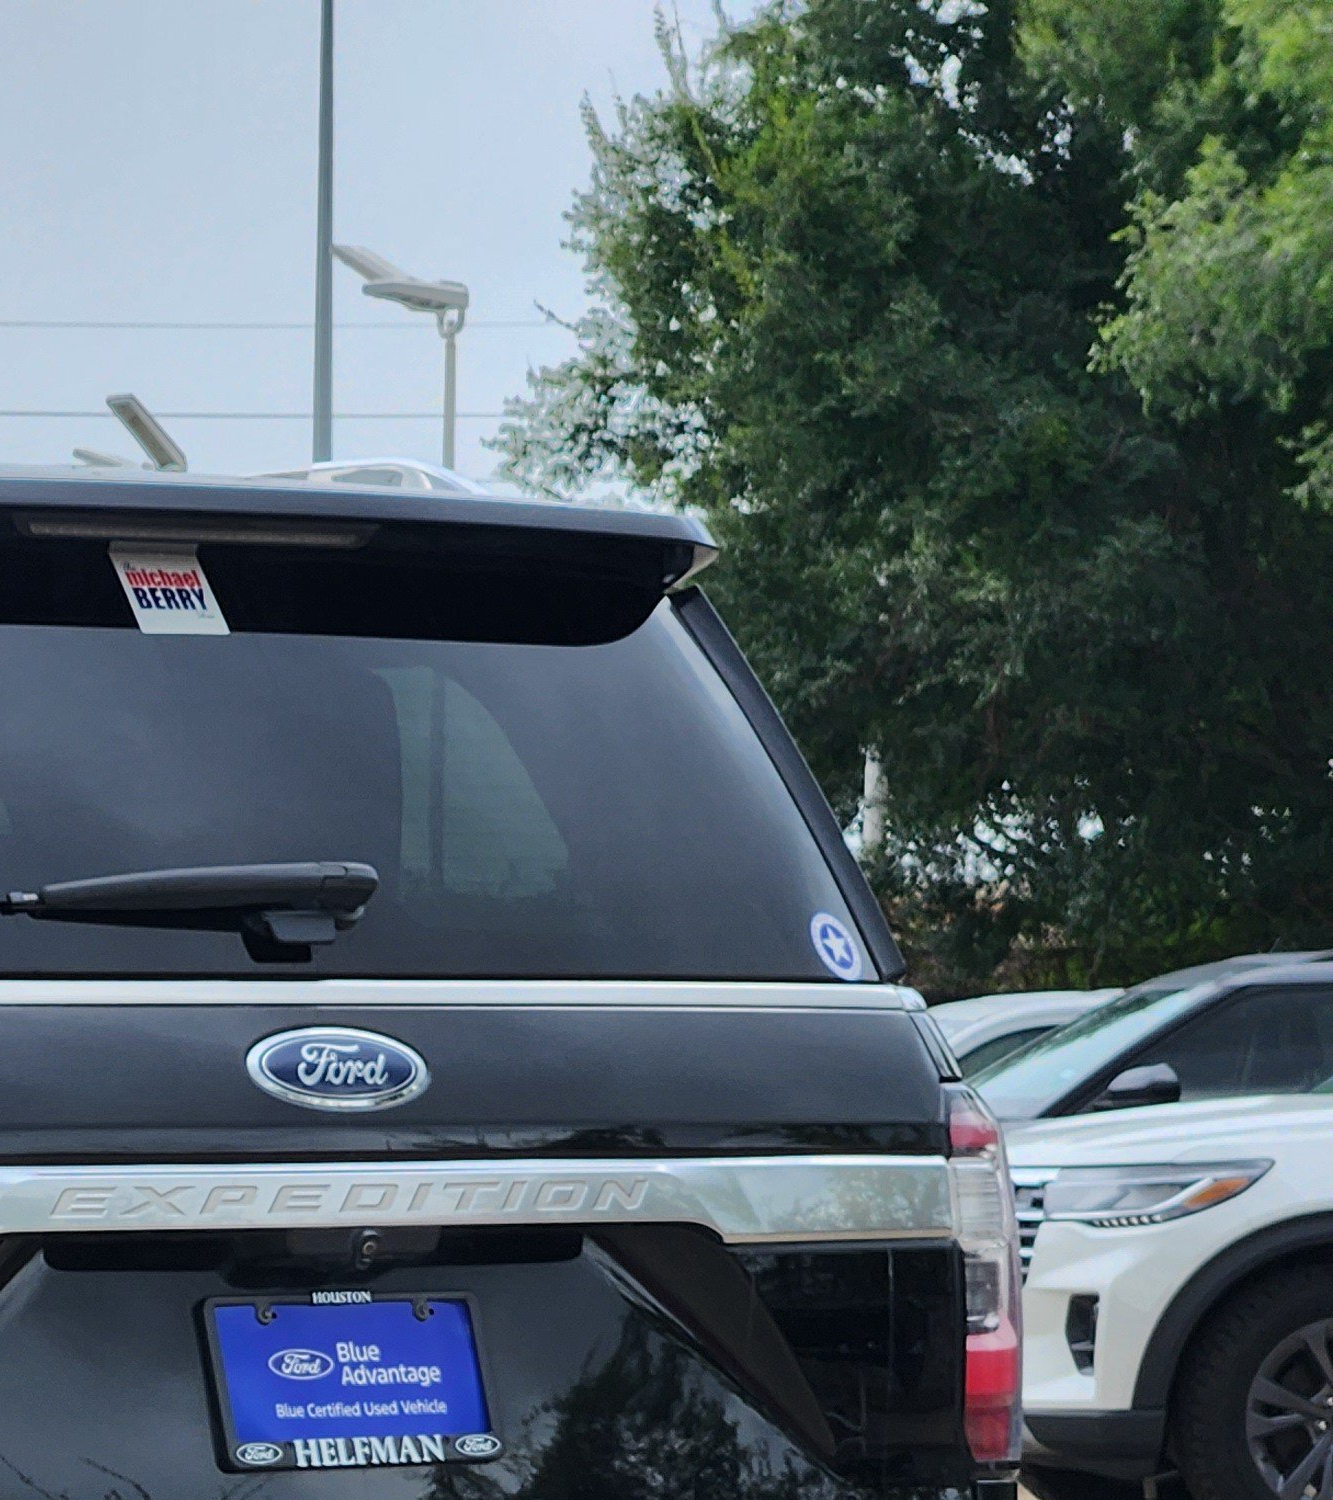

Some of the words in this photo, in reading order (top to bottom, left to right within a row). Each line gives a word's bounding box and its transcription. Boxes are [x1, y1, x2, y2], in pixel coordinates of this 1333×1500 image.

[125, 569, 202, 588] michael
[132, 587, 207, 610] BERRY
[296, 1043, 389, 1087] Ford
[49, 1178, 649, 1219] EXPEDITION
[312, 1290, 372, 1304] HOUSTON
[336, 1341, 380, 1363] Blue
[281, 1353, 322, 1374] Ford
[342, 1364, 441, 1387] Advantage
[275, 1404, 305, 1418] Blue
[306, 1402, 362, 1417] Certified
[364, 1401, 399, 1416] Used
[400, 1399, 448, 1415] Vehicle
[244, 1445, 275, 1460] Ford
[292, 1434, 447, 1468] HELFMAN
[462, 1437, 493, 1451] Ford
